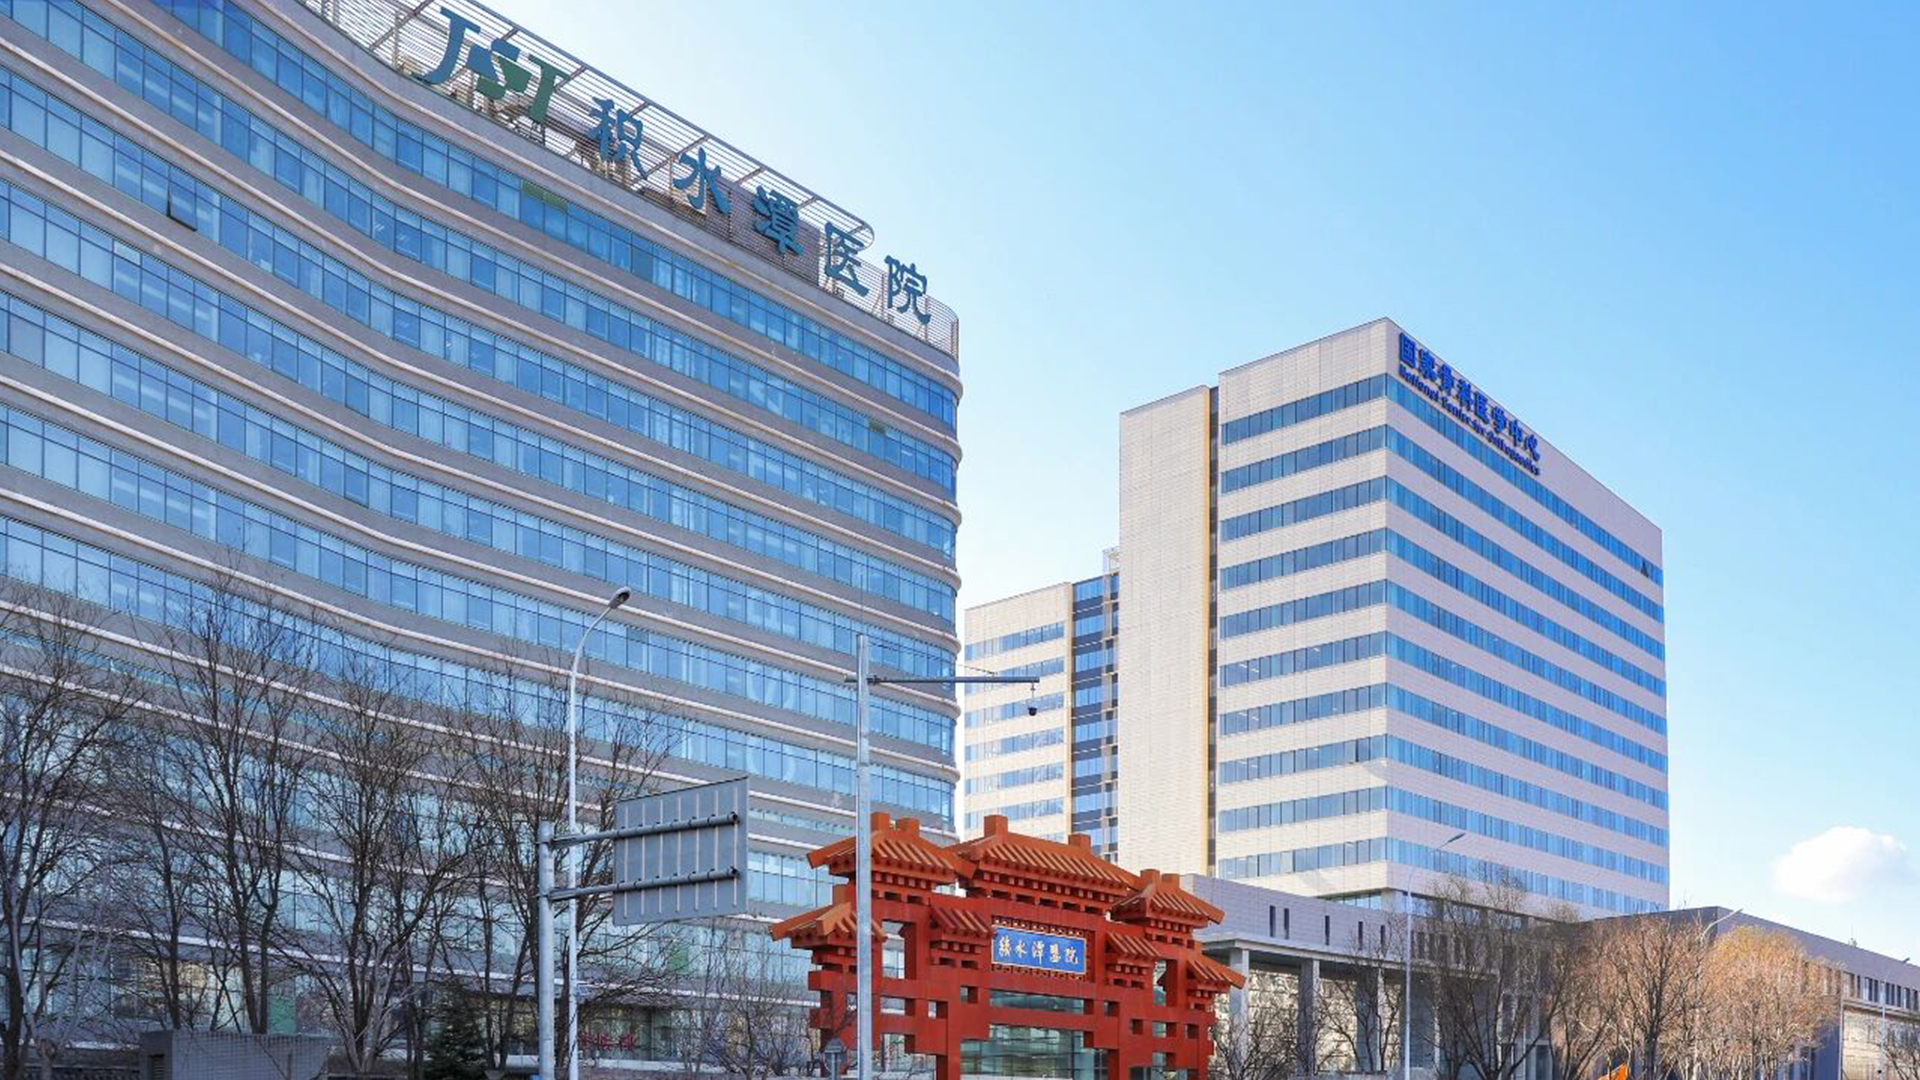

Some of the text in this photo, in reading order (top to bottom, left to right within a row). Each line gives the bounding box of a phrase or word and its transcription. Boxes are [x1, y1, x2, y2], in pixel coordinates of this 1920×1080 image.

[423, 7, 570, 122] JST
[588, 97, 931, 324] 积水潭医院
[1399, 364, 1439, 402] National
[1399, 333, 1540, 461] 国家骨科医学中心
